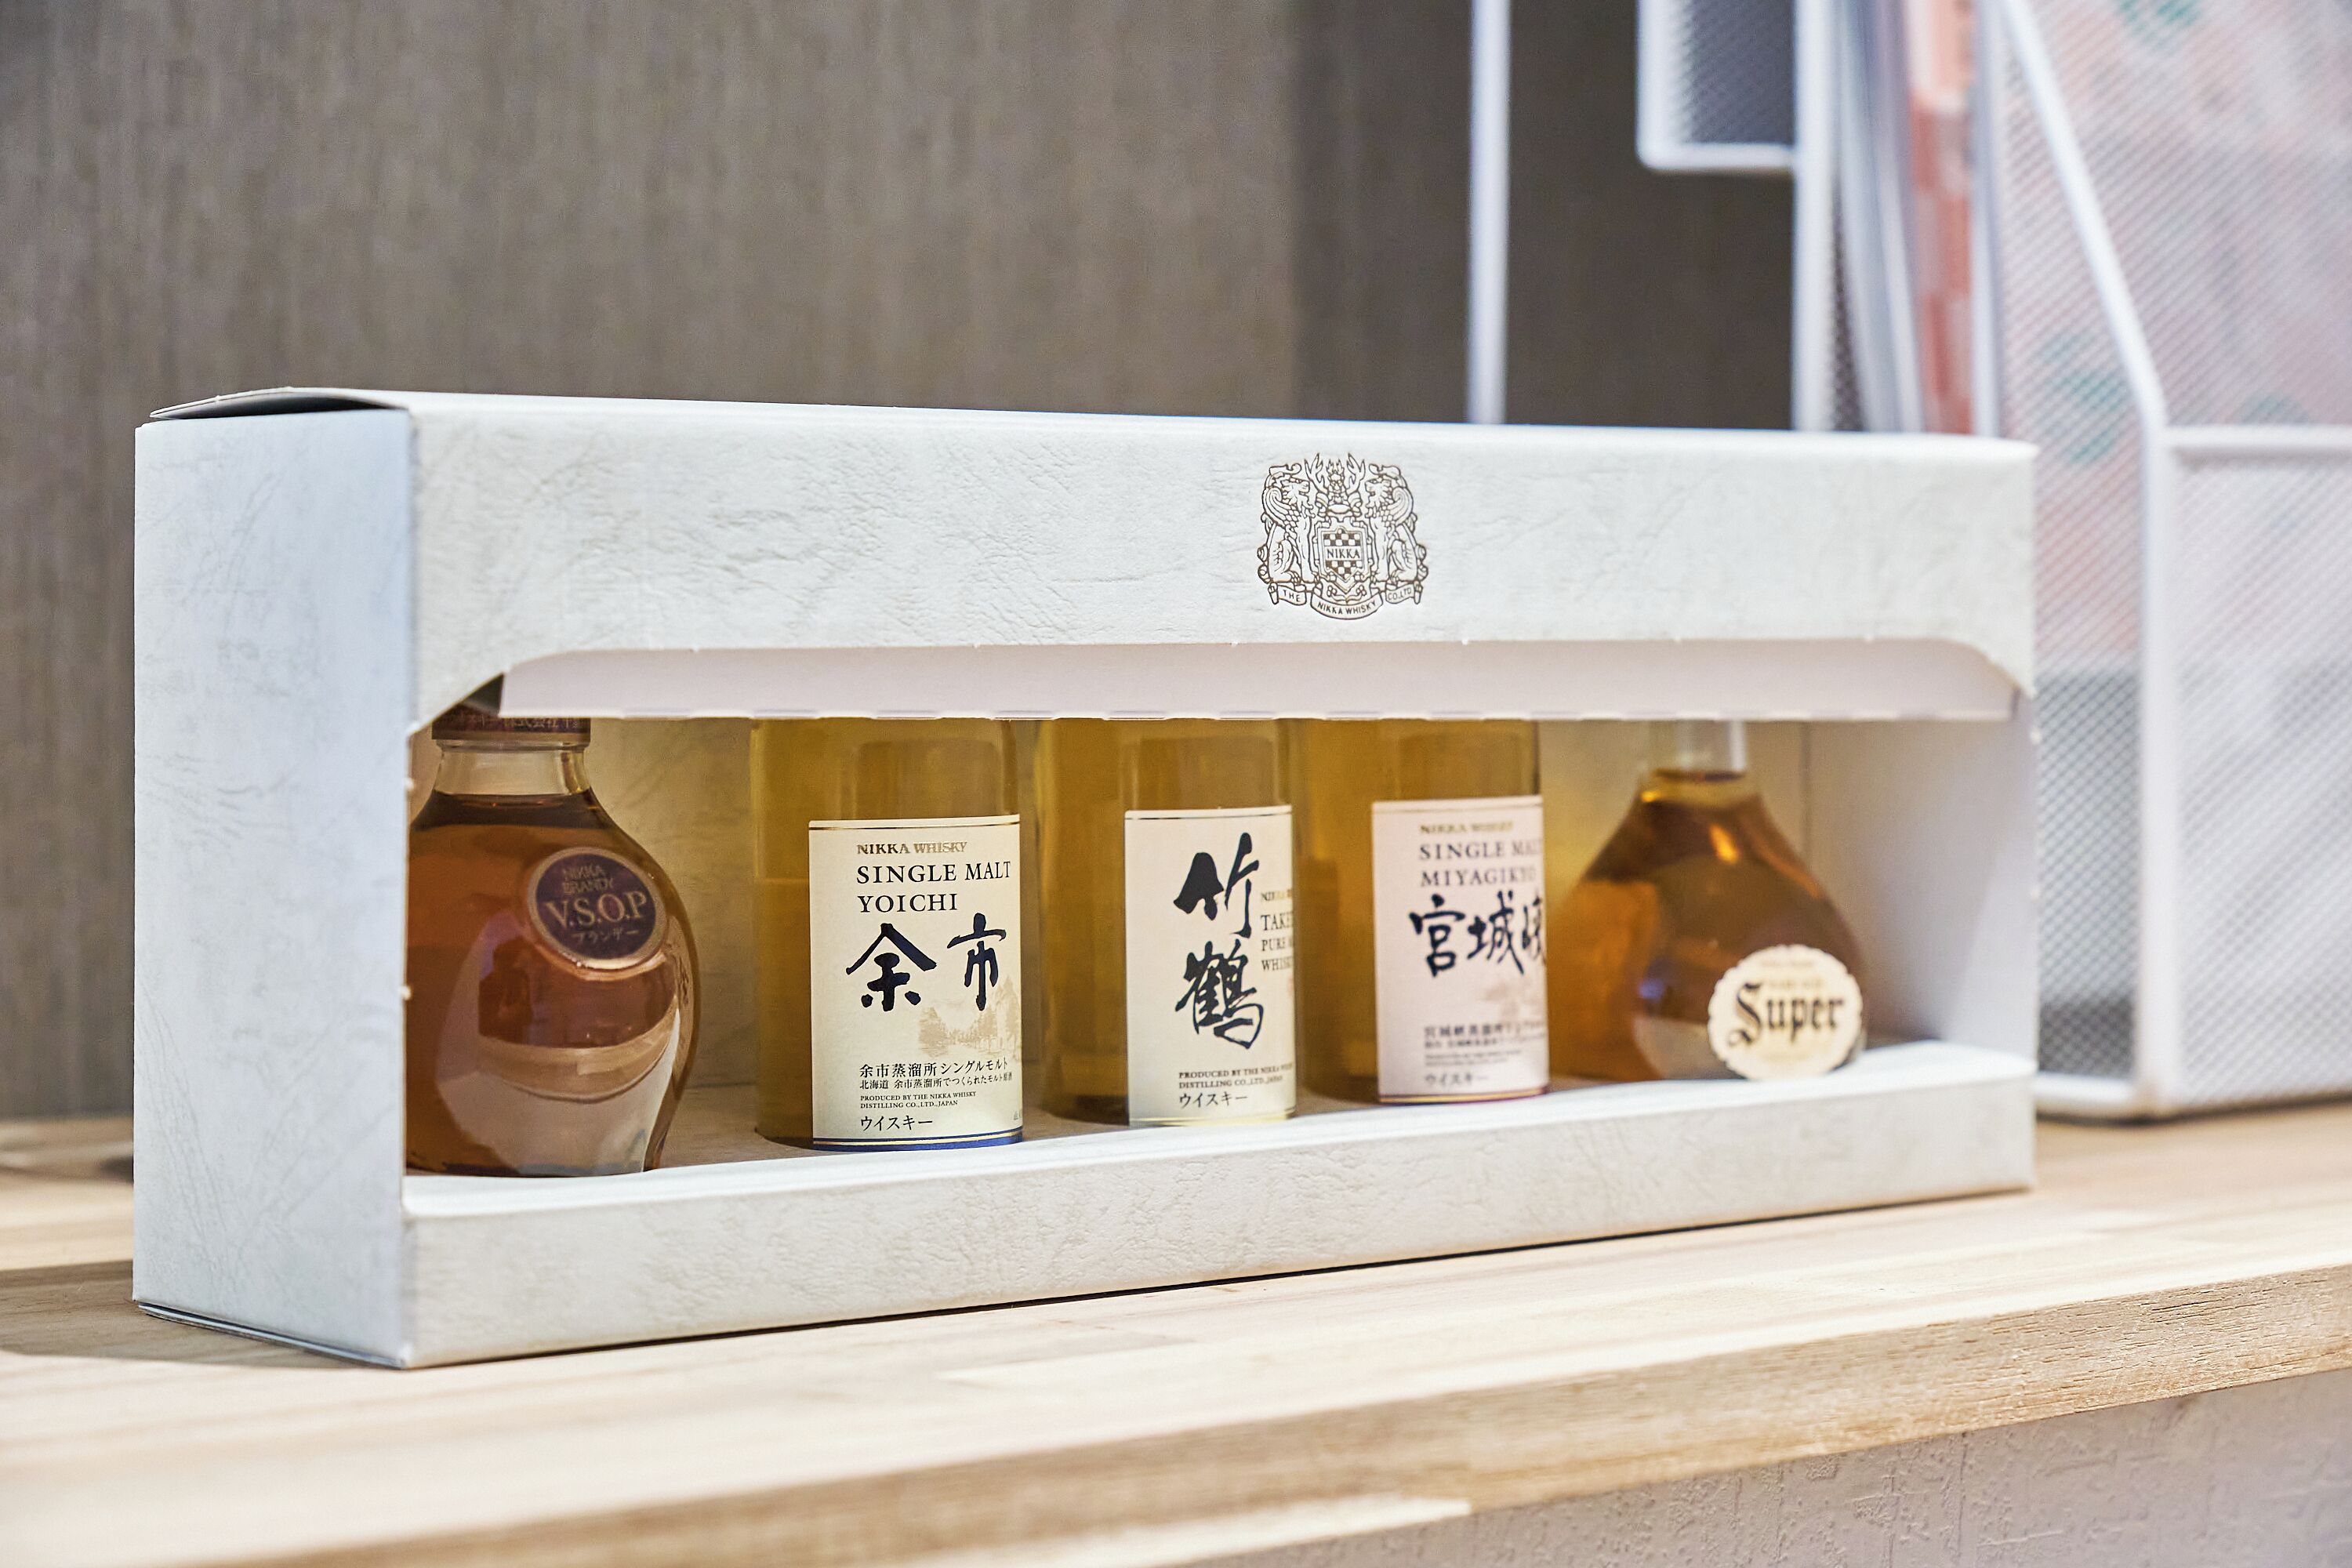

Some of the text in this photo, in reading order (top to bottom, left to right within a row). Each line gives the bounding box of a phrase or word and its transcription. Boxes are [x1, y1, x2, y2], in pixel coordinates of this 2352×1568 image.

[1327, 549, 1360, 559] NIKKA
[1283, 590, 1301, 603] THE
[1317, 602, 1343, 615] NIKKA
[1345, 602, 1377, 615] WHISKY
[857, 841, 967, 855] NIKKA WHISKY
[1419, 841, 1505, 860] SINGLE
[856, 860, 1011, 884] SINGLE MALT
[544, 890, 648, 930] V.S.O.P
[857, 893, 959, 913] YOICHI
[1173, 832, 1265, 1050] 竹鶴
[845, 913, 1007, 1012] 余市
[1727, 982, 1845, 1045] Super
[859, 1056, 1008, 1079] 余市蒸溜所シングルモルト
[1178, 1070, 1229, 1079] PRODUCED
[859, 1079, 889, 1090] 北海道
[1178, 1080, 1232, 1089] DISTILLING
[1178, 1091, 1249, 1109] ウイスキー
[860, 1115, 933, 1131] ウイスキー
